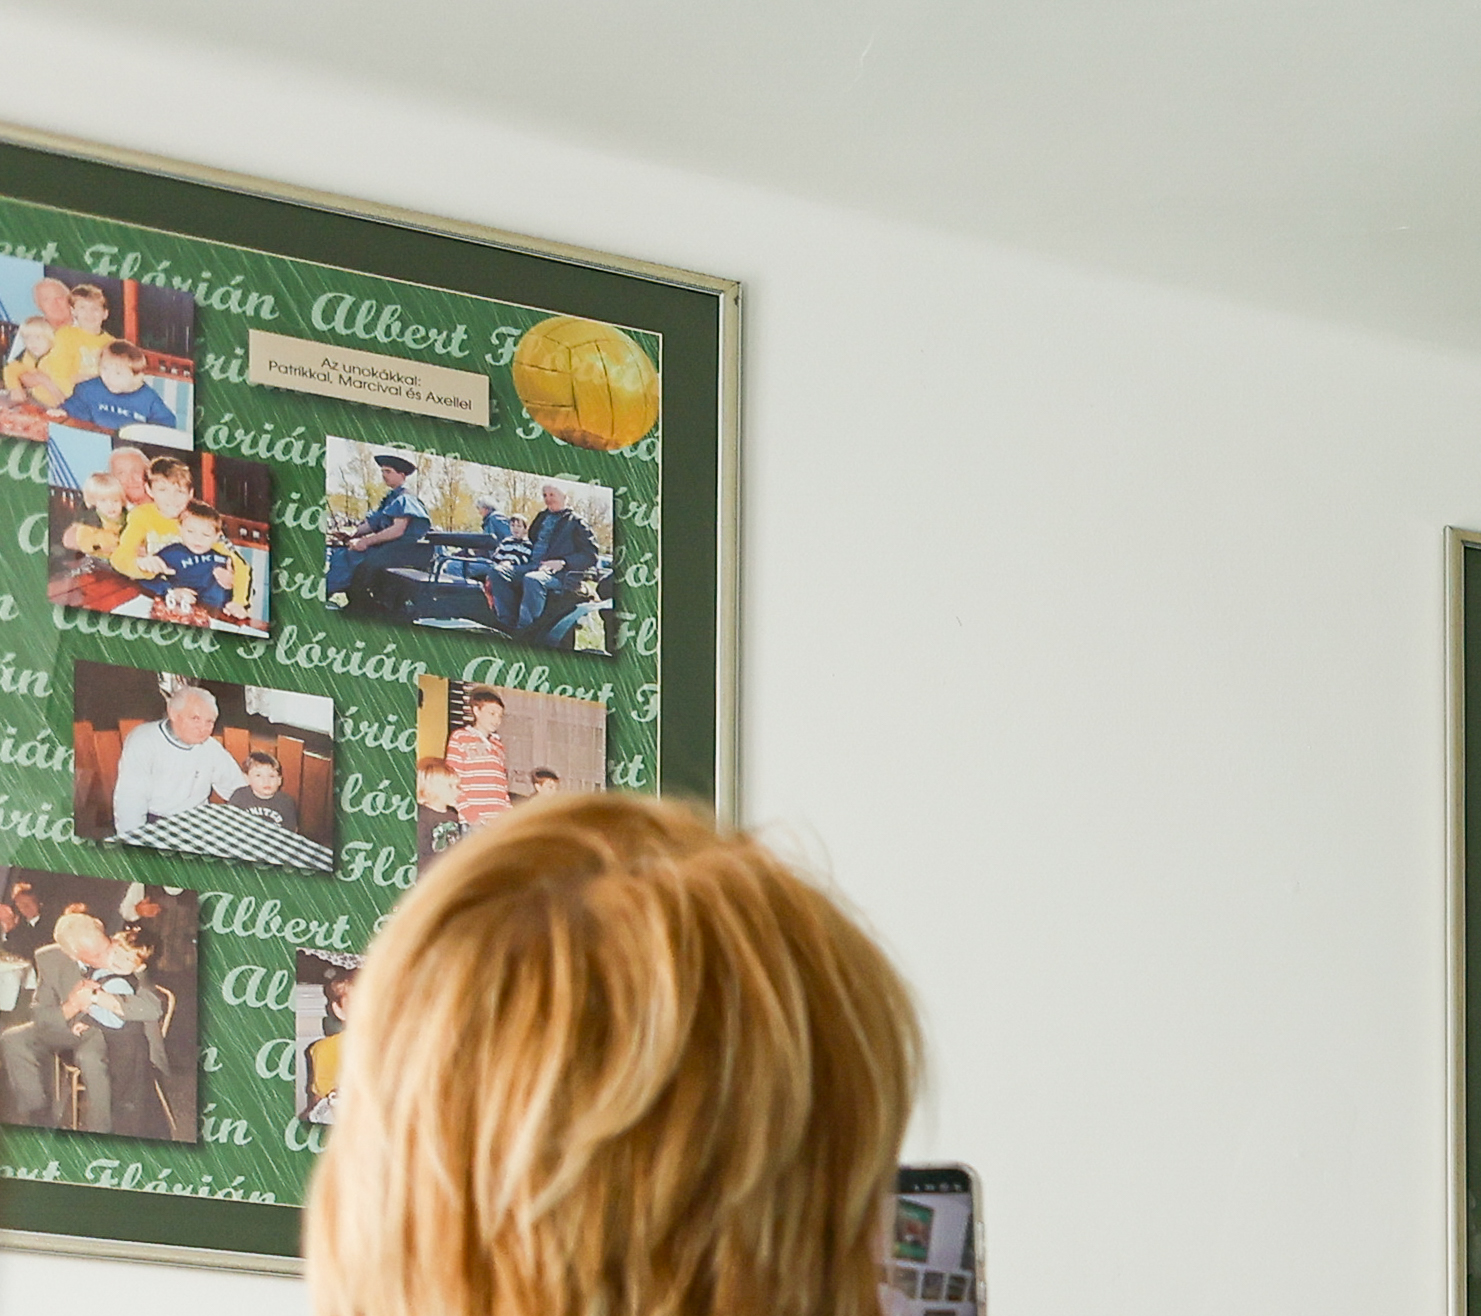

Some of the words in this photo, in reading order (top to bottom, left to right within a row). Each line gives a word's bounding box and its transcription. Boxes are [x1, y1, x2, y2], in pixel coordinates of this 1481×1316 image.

[311, 291, 470, 359] Albert
[268, 359, 333, 384] Patrikkal,
[338, 373, 402, 398] Marcival
[406, 386, 422, 400] és
[425, 389, 472, 411] Axellel
[320, 356, 340, 371] Az
[343, 361, 421, 387] unokákkal:
[198, 890, 353, 951] Albert
